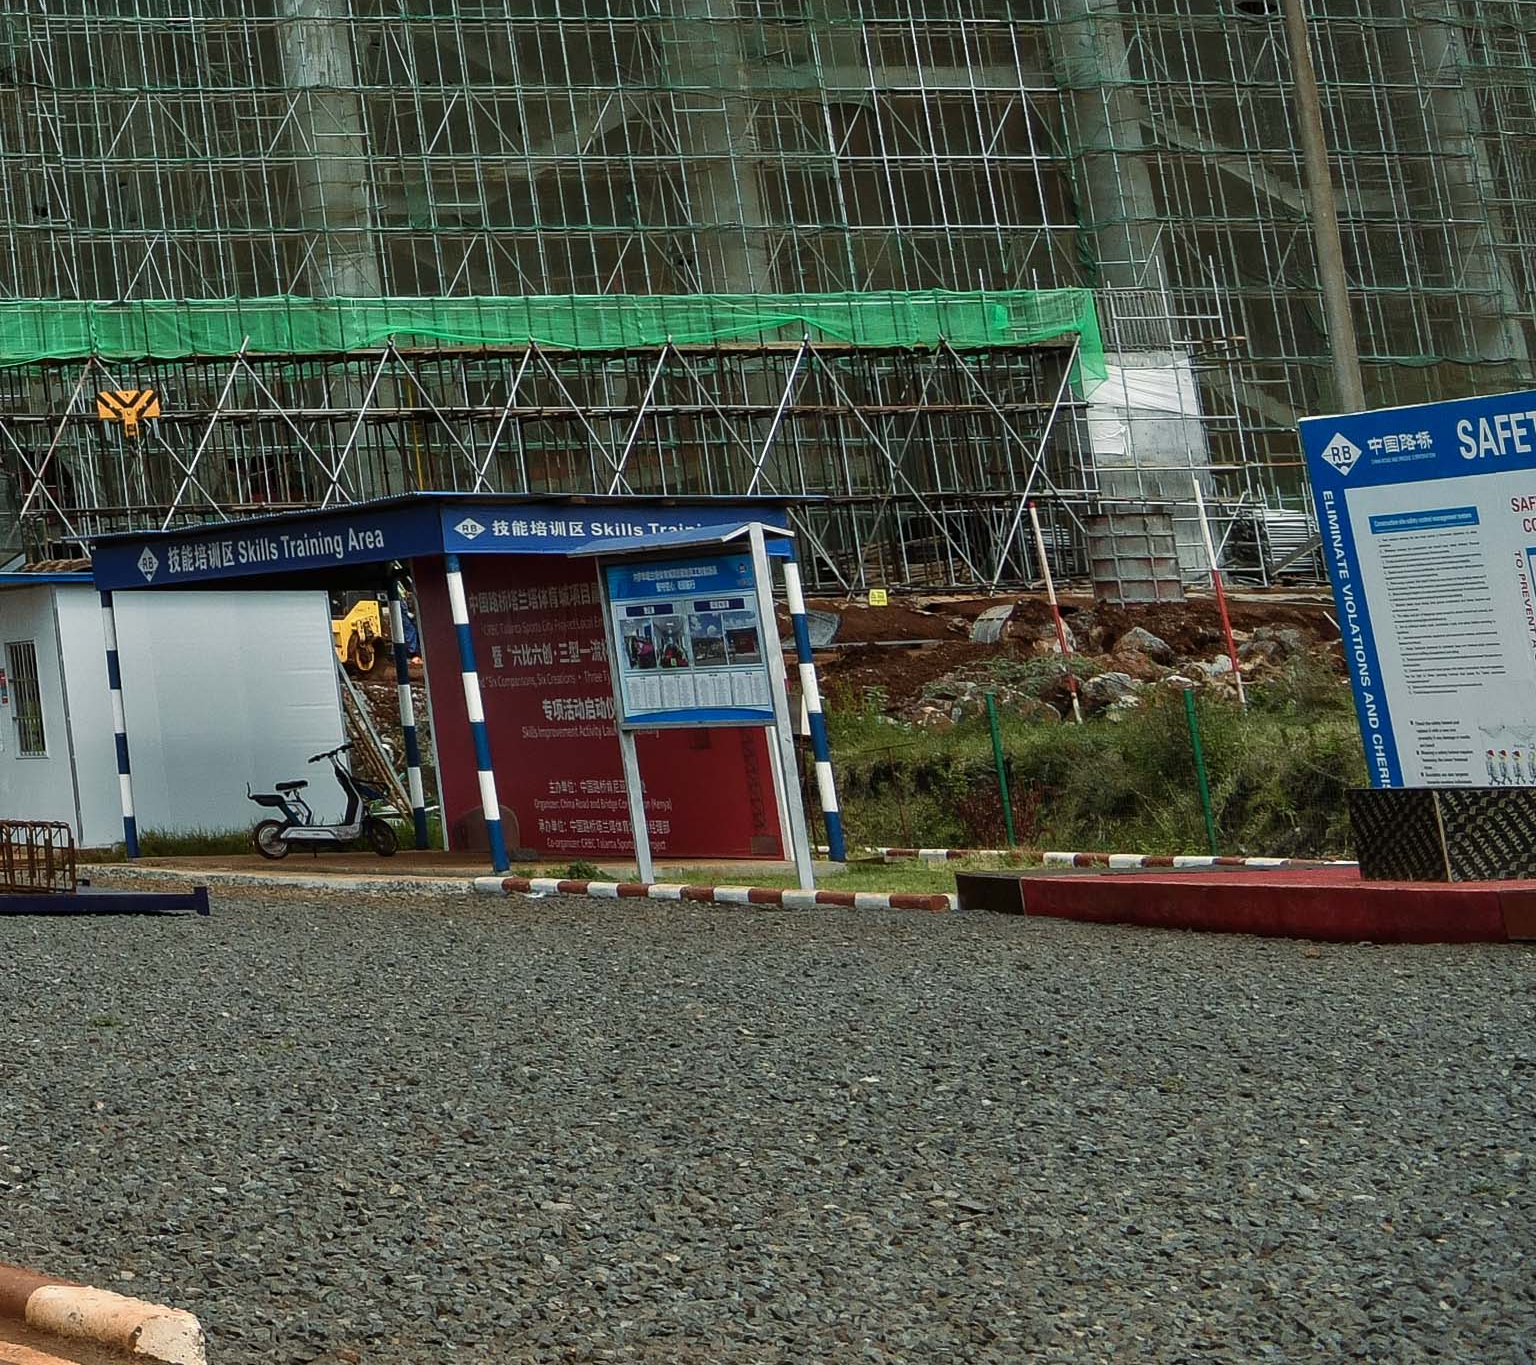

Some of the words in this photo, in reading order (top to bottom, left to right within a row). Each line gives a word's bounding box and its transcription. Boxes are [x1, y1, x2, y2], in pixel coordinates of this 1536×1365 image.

[1331, 446, 1352, 462] RB
[1368, 431, 1433, 456] 中国路桥
[492, 520, 586, 537] 技能培训区
[591, 522, 643, 536] Skills
[168, 540, 236, 574] 技能培训区
[238, 537, 279, 562] Skills
[280, 530, 343, 560] Training
[348, 527, 384, 552] Area
[1514, 550, 1524, 568] TO
[1323, 490, 1350, 579] ELIMINATE
[1341, 584, 1372, 687] VIOLATIONS
[1363, 692, 1380, 729] AND
